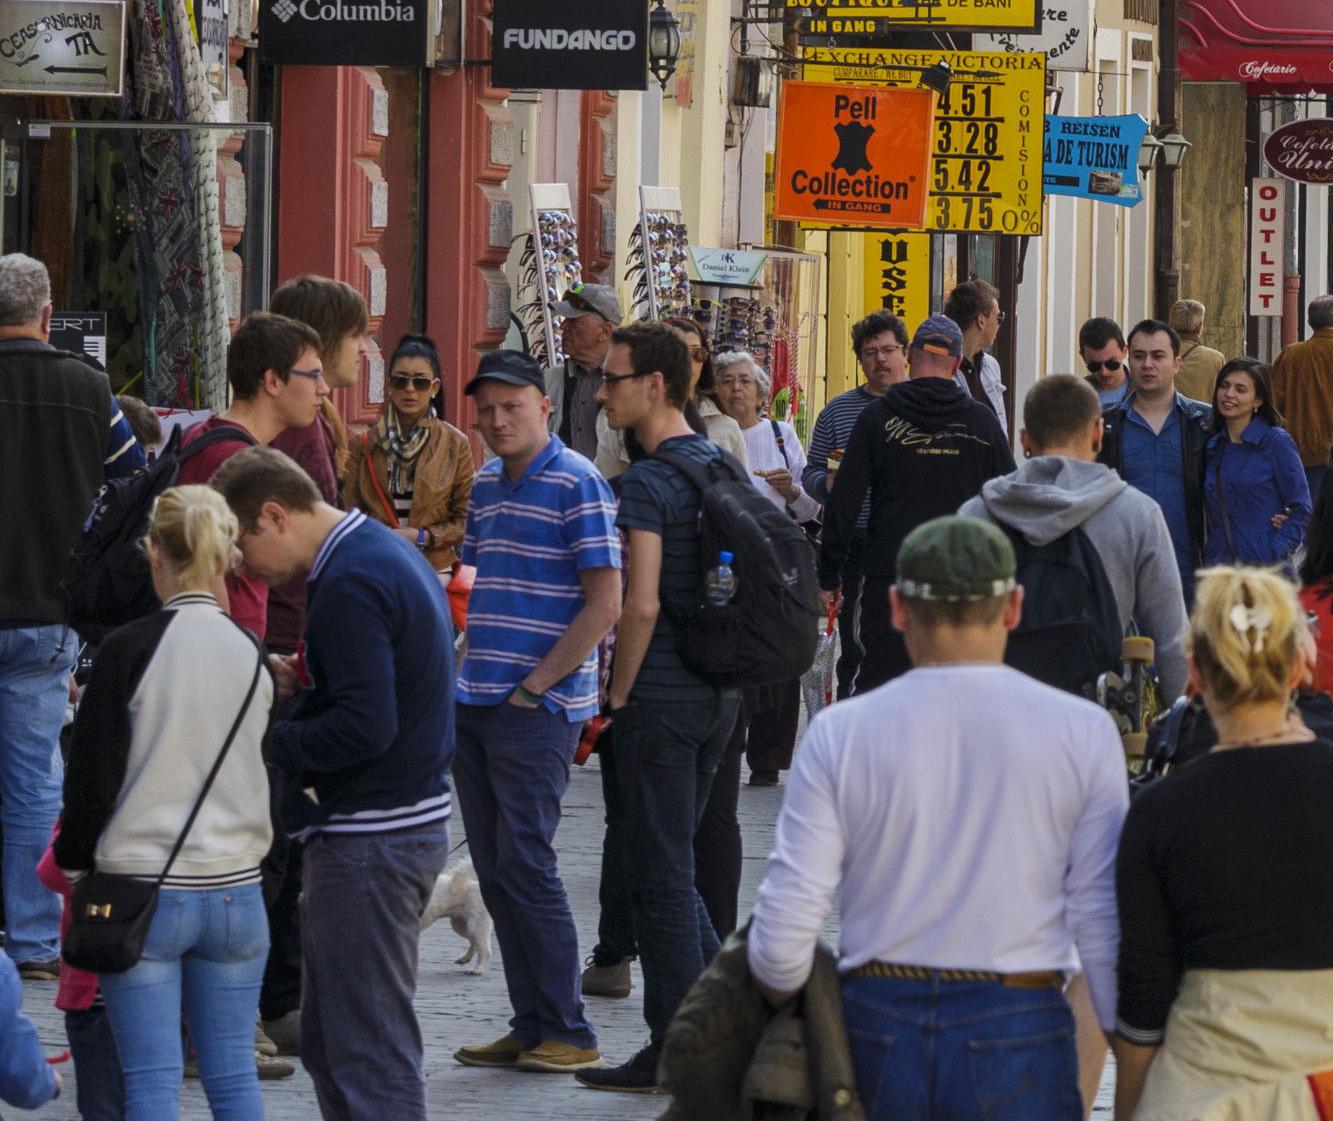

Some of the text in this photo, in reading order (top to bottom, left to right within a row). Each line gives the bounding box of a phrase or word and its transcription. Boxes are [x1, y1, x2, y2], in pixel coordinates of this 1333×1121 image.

[503, 28, 637, 51] FUNDANGO
[810, 19, 876, 33] IN GANG
[65, 30, 108, 58] TA
[813, 50, 1044, 71] EXCHANGE VICTORIA
[833, 94, 877, 120] Pell
[936, 120, 999, 156] 3.28
[1060, 121, 1122, 139] REISEN
[1017, 89, 1031, 207] COMISION
[1056, 139, 1072, 166] DE
[1077, 141, 1130, 170] TURISM
[791, 169, 909, 200] Collection
[934, 159, 992, 192] 5.42
[827, 200, 882, 213] IN GANG
[935, 196, 993, 230] 3.75
[1258, 185, 1278, 309] OUTLET
[702, 263, 750, 274] Daniel Klein
